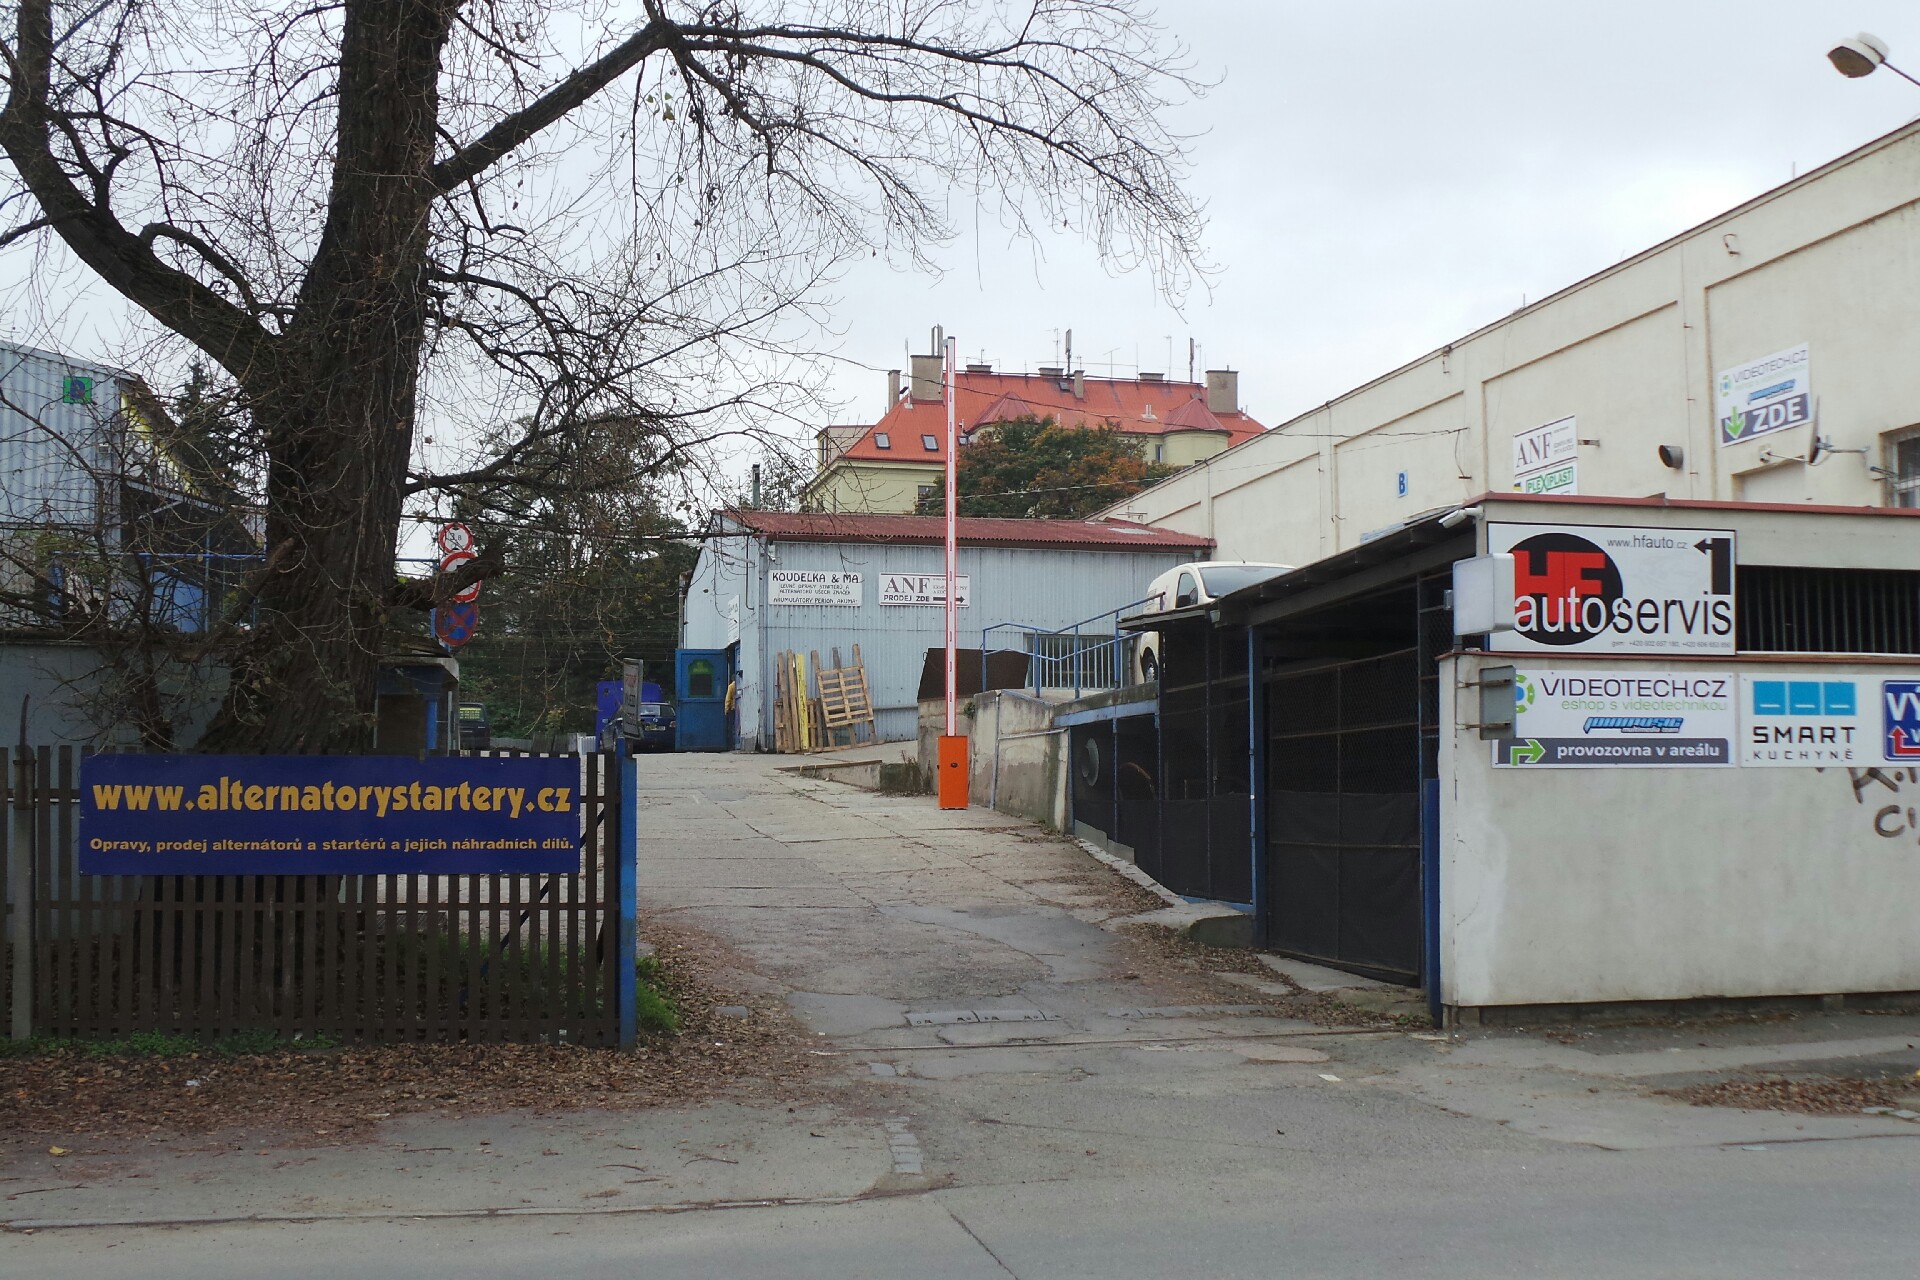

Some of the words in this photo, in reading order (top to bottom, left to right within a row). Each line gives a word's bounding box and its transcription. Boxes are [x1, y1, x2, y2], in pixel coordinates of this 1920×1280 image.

[1752, 397, 1803, 433] ZDE
[1516, 431, 1552, 468] ANF
[1398, 472, 1406, 495] B
[1607, 535, 1688, 549] www.hfauto.cz
[772, 572, 826, 583] KOUDELKA
[831, 573, 840, 583] &
[884, 576, 931, 594] ANF
[1514, 550, 1605, 623] HF
[883, 594, 912, 602] PRODEJ
[1514, 586, 1732, 636] autoservis
[1540, 678, 1728, 698] VIDEOTECH.CZ
[1561, 699, 1606, 712] eshop
[1610, 701, 1618, 710] s
[1622, 698, 1728, 711] videotechnikou
[1753, 726, 1856, 744] SMART
[1557, 744, 1652, 759] provozovna
[1657, 746, 1666, 756] v
[1670, 742, 1720, 756] areálu
[92, 776, 571, 819] www.alternatorystartery.cz
[89, 838, 151, 853] Opravy,
[156, 838, 208, 854] prodej
[212, 837, 302, 851] alternátorů
[307, 841, 317, 851] a
[322, 837, 386, 850] startérů
[391, 841, 400, 850] a
[403, 838, 447, 853] jejich
[452, 837, 537, 850] náhradních
[542, 837, 574, 850] dílů.
